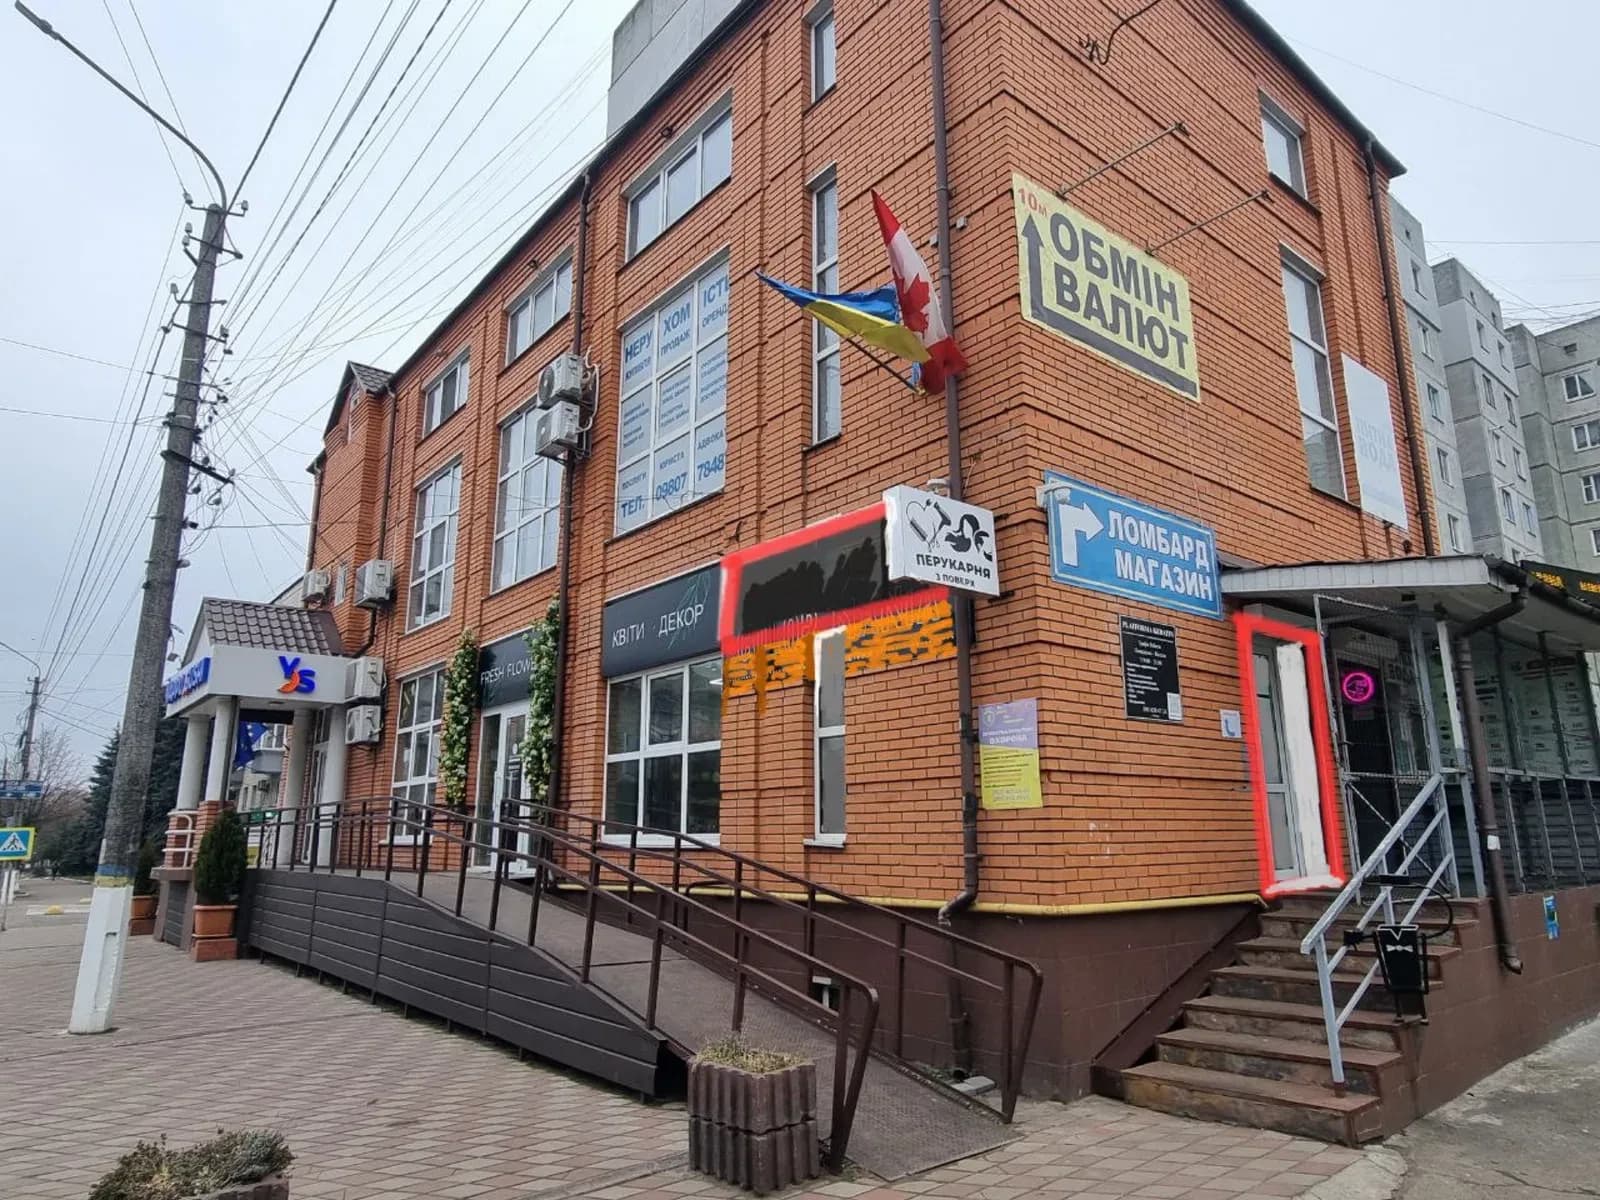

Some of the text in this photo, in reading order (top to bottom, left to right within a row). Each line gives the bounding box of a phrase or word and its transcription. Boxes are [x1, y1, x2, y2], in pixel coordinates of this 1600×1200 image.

[1050, 212, 1180, 322] ОБМІН
[625, 329, 653, 363] НЕРУ
[663, 303, 691, 336] ХОМ
[1054, 262, 1188, 370] ВАЛЮТ
[656, 472, 688, 501] 09807
[1108, 510, 1210, 573] ЛОМБАРД
[916, 553, 991, 580] ПЕРУКАРНЯ
[942, 573, 975, 587] ПОВЕРХ
[1114, 549, 1213, 602] МАГАЗИН
[612, 604, 704, 648] КВІТИ ДЕКОР
[480, 664, 505, 686] FRESH
